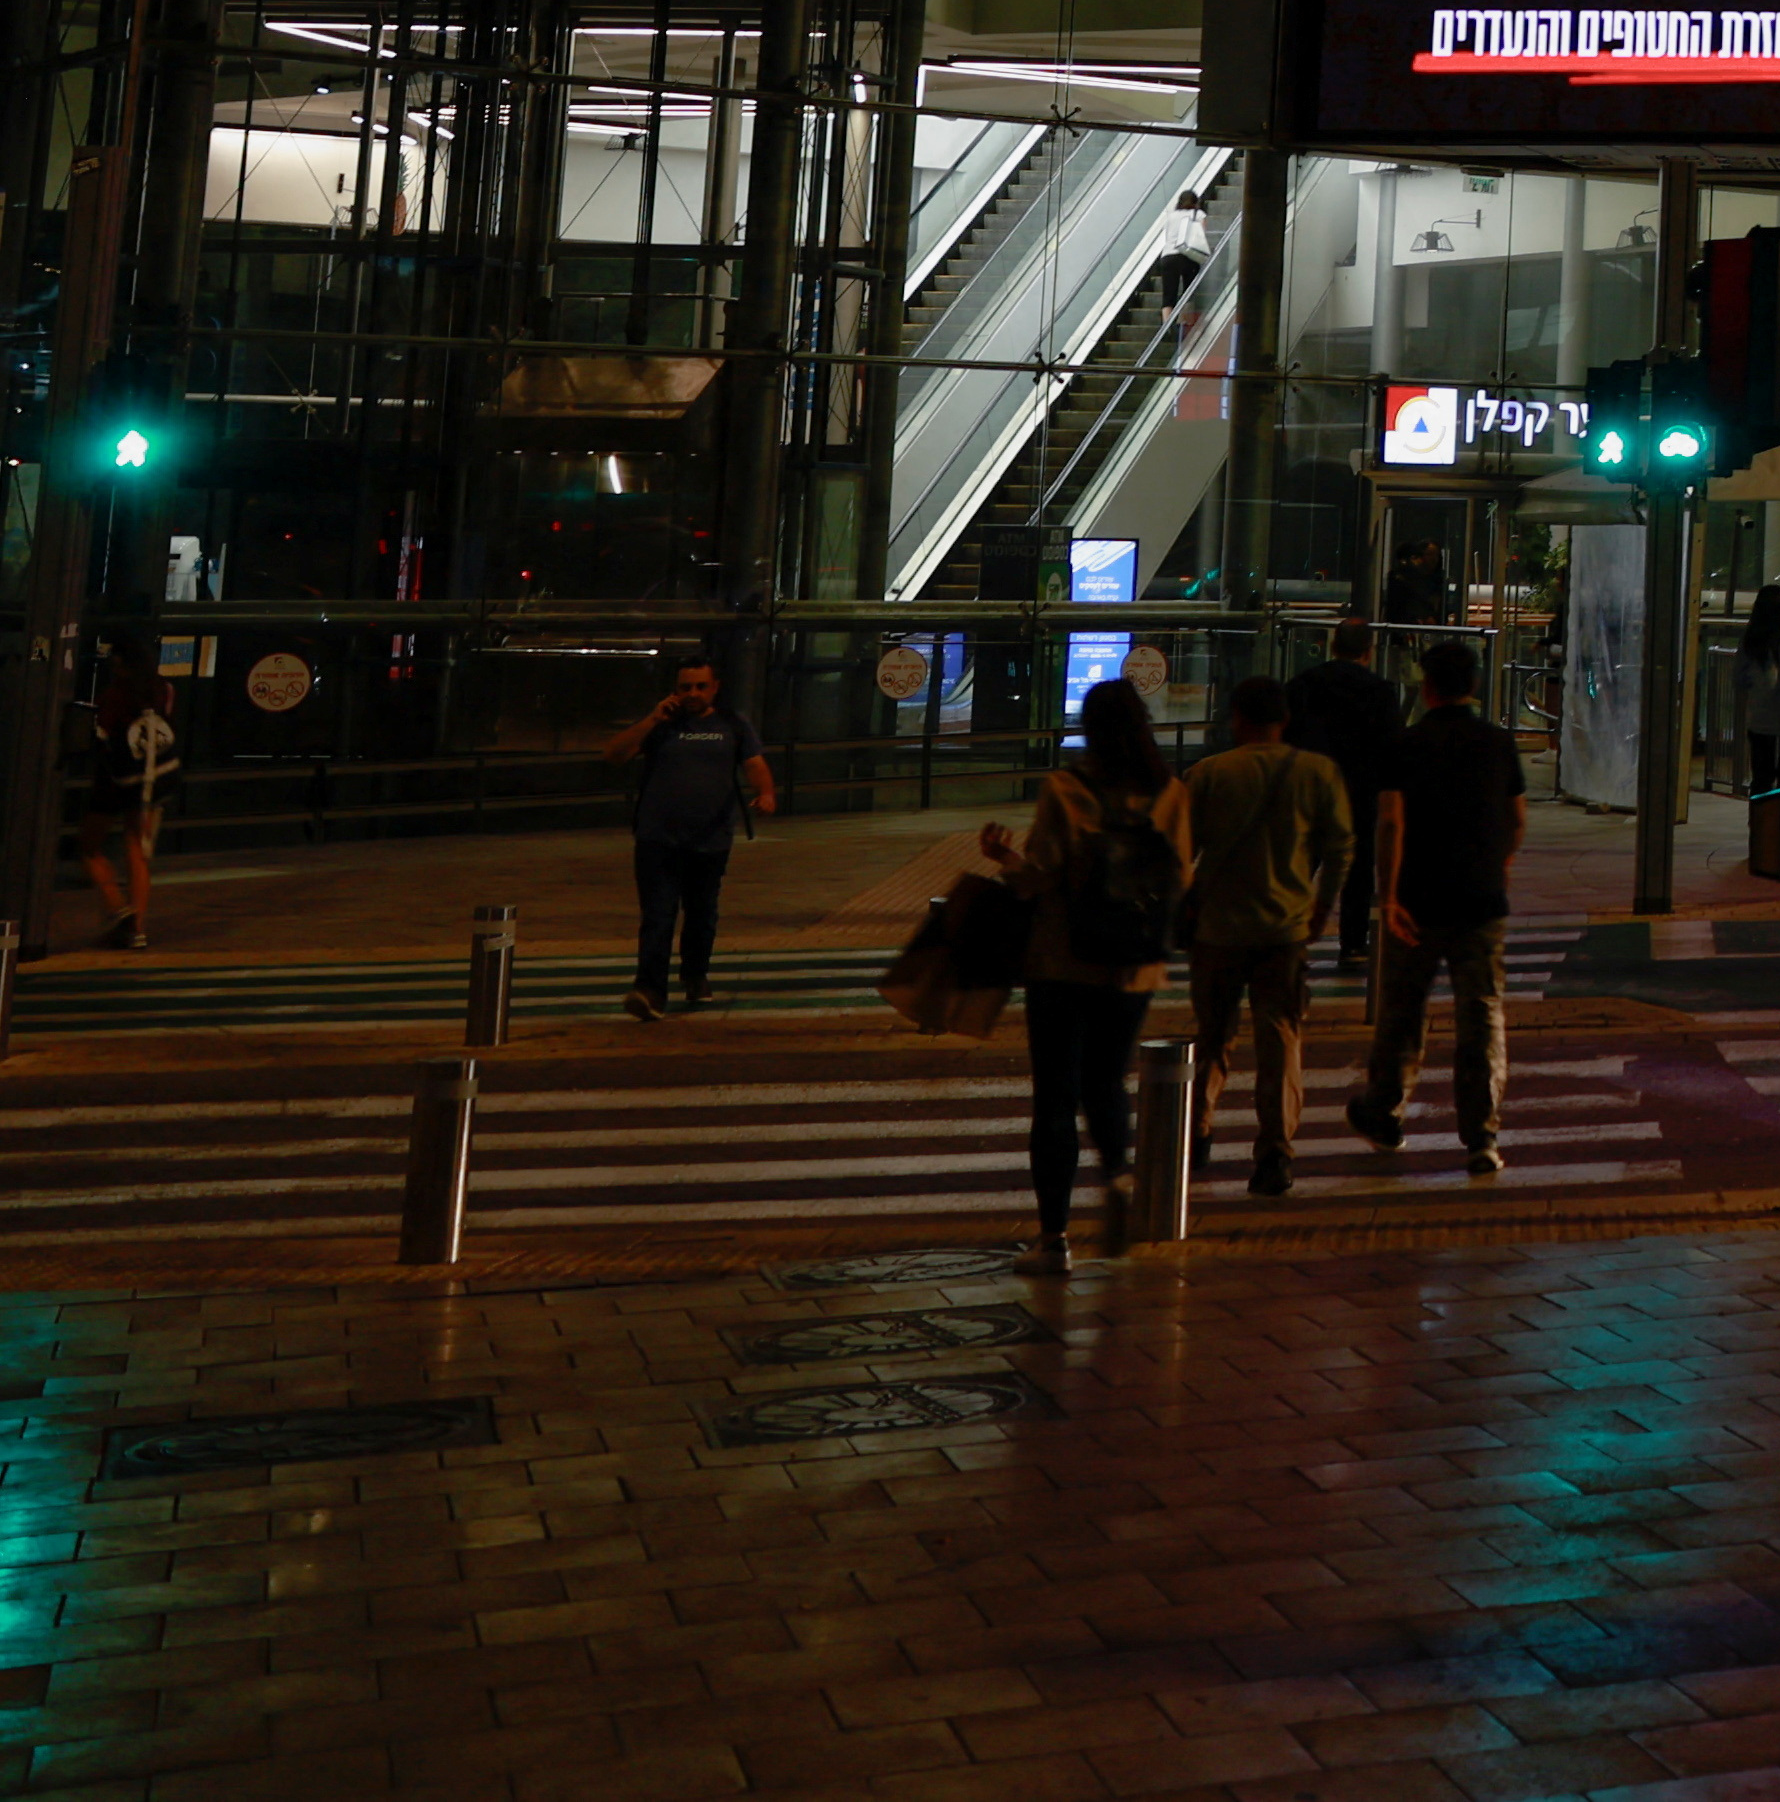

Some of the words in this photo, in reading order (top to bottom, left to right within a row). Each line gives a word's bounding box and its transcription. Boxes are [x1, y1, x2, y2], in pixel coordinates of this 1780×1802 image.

[1431, 9, 1572, 58] והנעדרים
[1576, 9, 1713, 59] החטופים
[1465, 389, 1550, 447] קפלן
